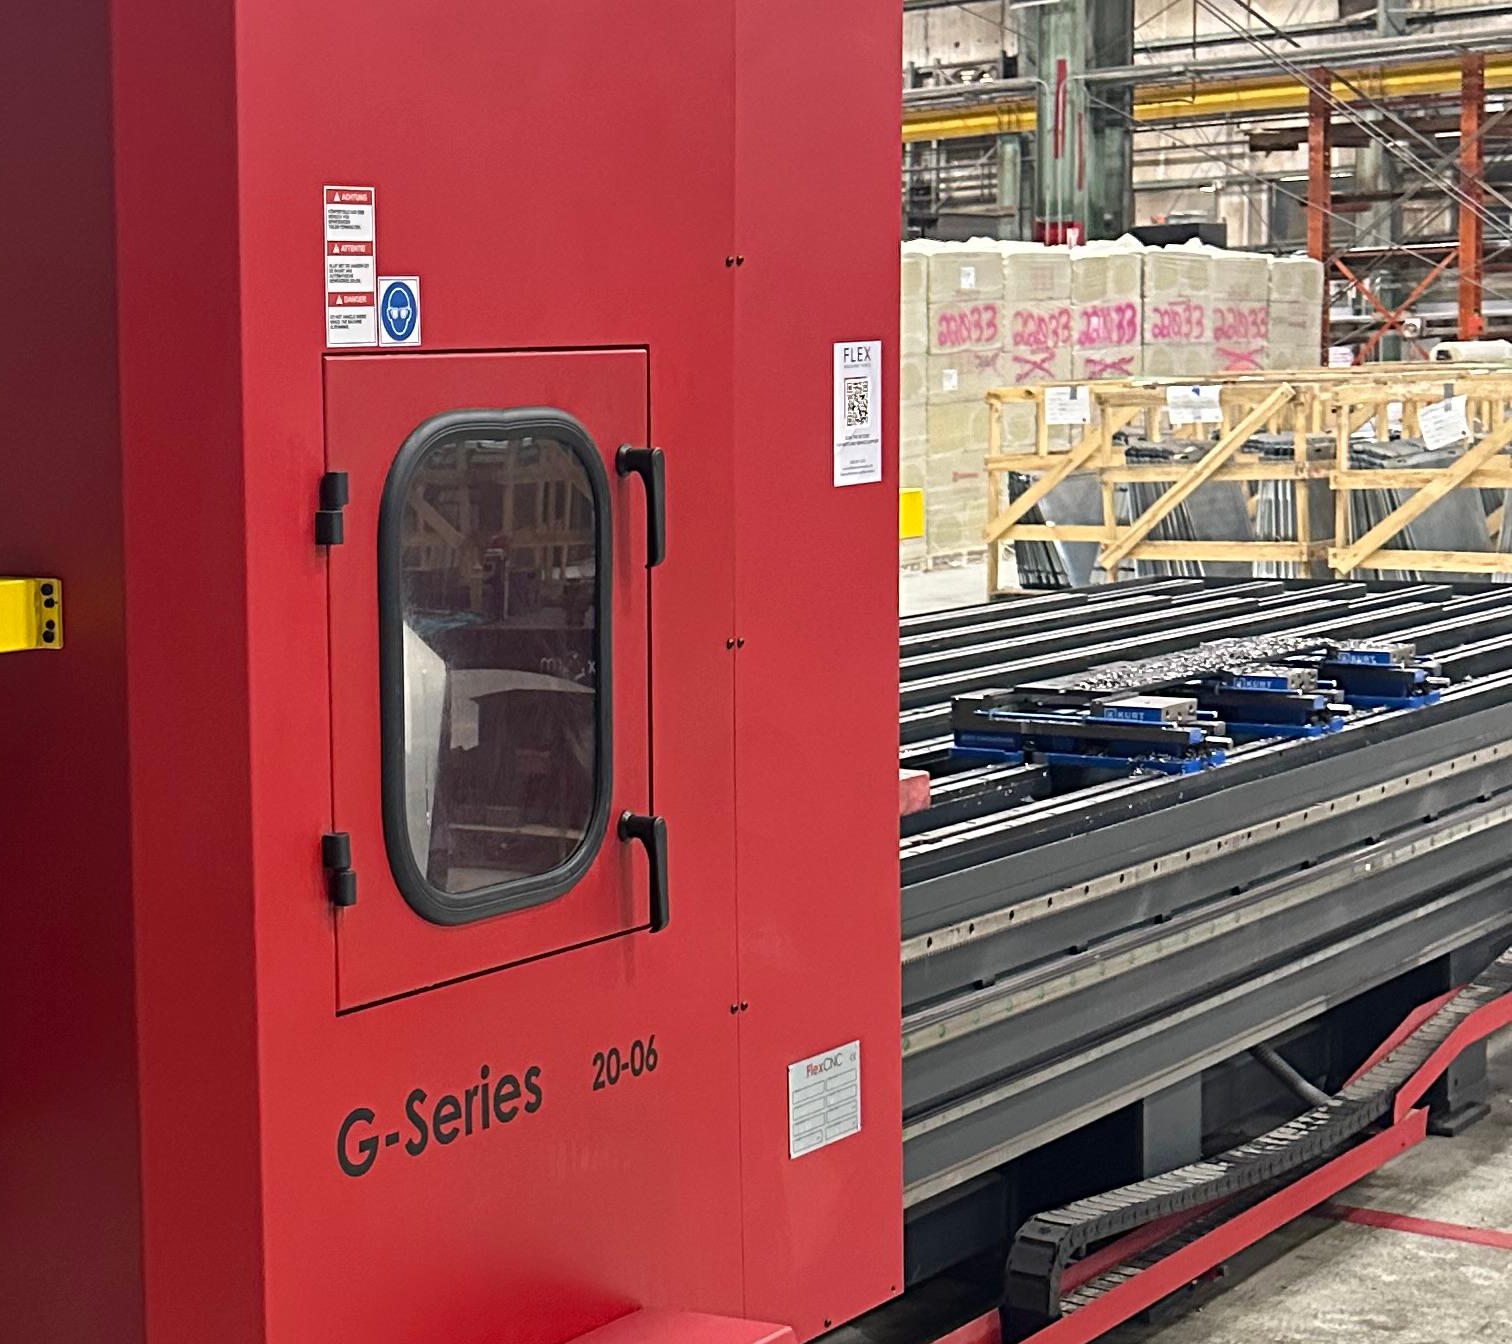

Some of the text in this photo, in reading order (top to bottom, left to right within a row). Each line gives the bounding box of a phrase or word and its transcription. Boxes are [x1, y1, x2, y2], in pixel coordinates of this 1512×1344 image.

[343, 295, 367, 304] DANGER
[843, 346, 872, 363] FLEX
[592, 1034, 659, 1091] 20-06
[806, 1053, 843, 1077] FlexCNC
[337, 1064, 542, 1177] G-Series
